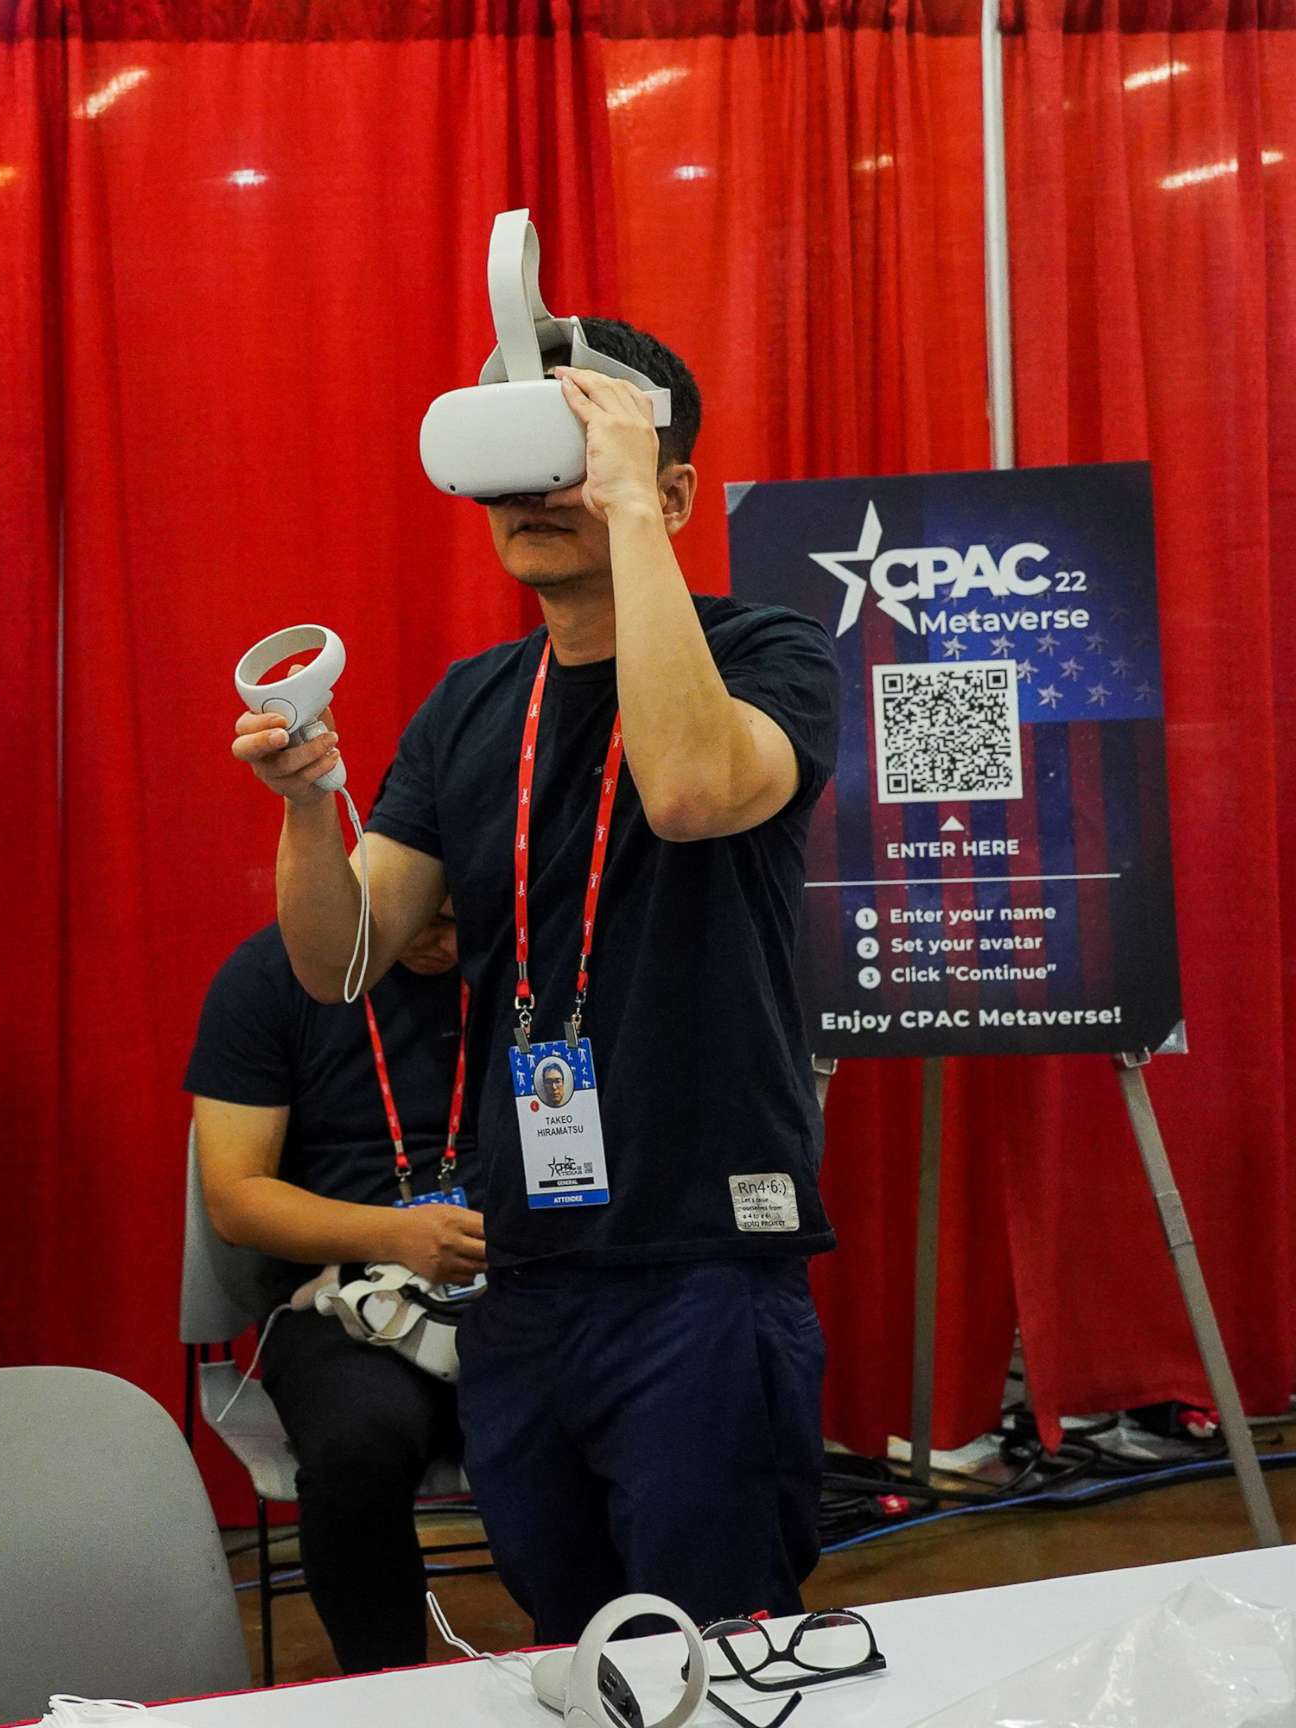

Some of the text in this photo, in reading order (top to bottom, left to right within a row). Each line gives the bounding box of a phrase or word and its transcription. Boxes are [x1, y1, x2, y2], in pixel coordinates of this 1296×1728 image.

[870, 542, 1087, 601] CPAC 22
[920, 608, 1090, 635] Metaverse
[887, 839, 1020, 859] ENTER HERE
[890, 908, 943, 924] Enter
[949, 908, 994, 925] your
[1000, 906, 1057, 920] name
[891, 938, 923, 953] Set
[928, 938, 974, 955] your
[979, 935, 1043, 950] avatar
[891, 966, 941, 983] Click
[821, 1006, 1122, 1033] Enjoy CPAC Metaverse!
[545, 1115, 573, 1125] TAKEO
[537, 1125, 584, 1137] HIRAMATSU
